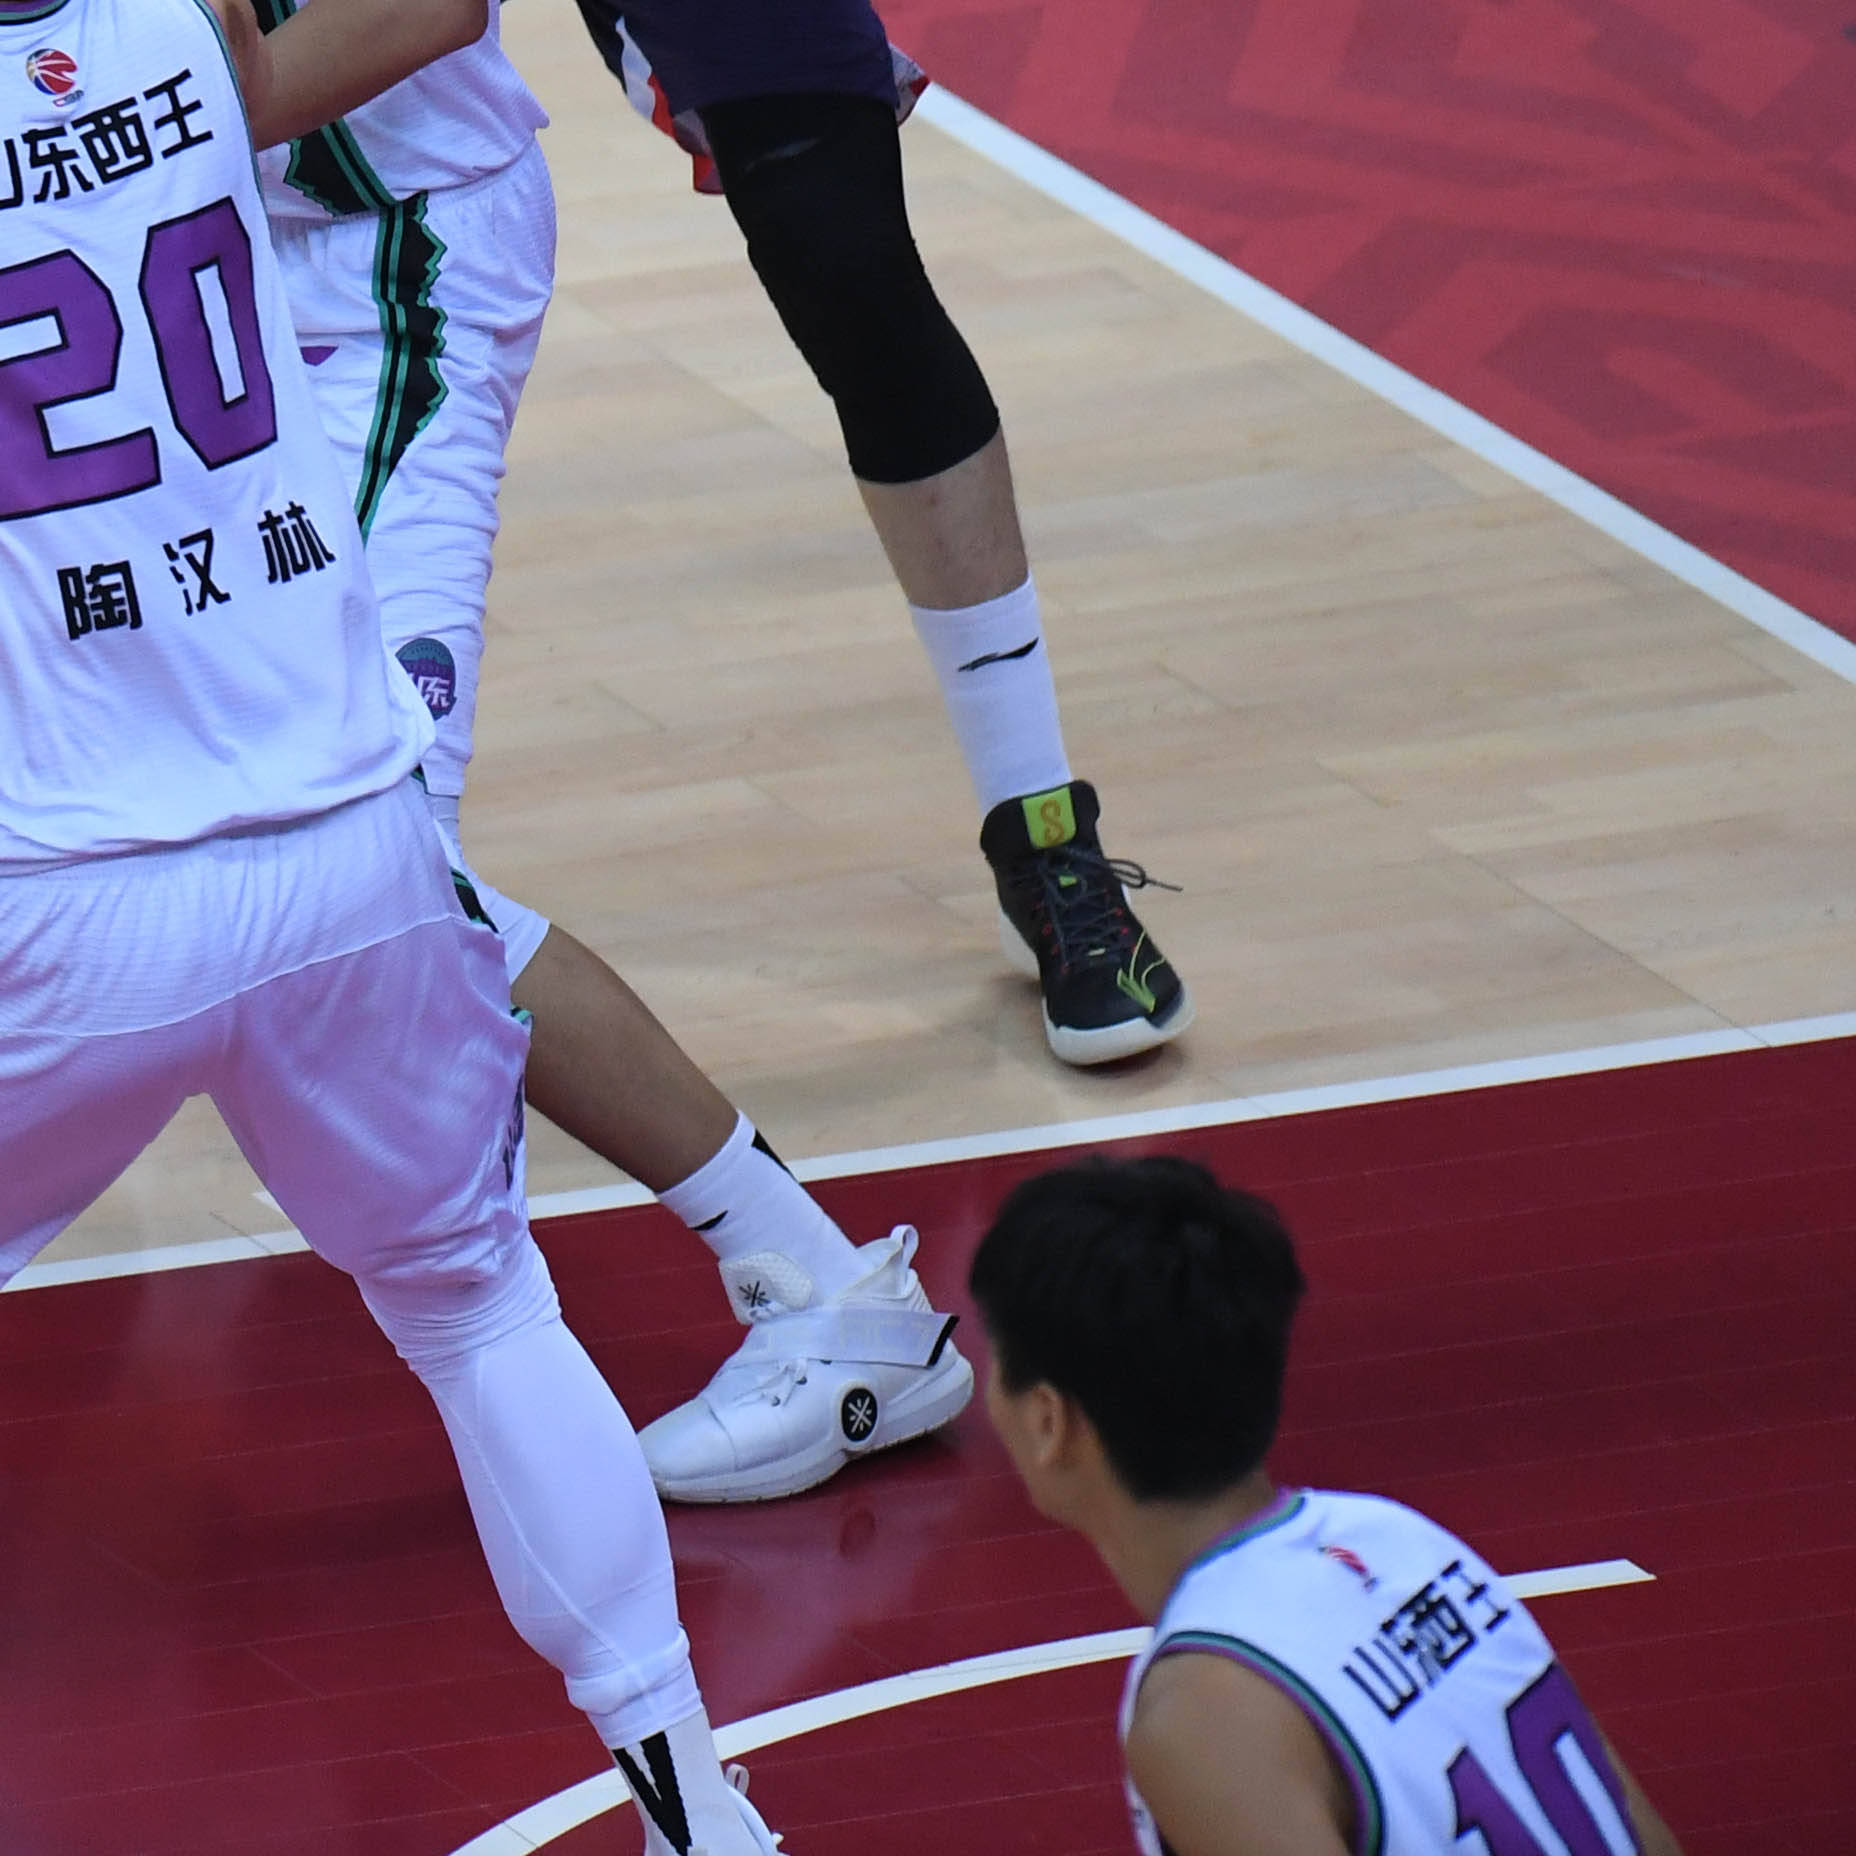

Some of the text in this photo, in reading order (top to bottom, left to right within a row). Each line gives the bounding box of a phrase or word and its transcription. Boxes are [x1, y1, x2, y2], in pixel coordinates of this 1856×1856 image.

[57, 501, 336, 640] 陶汉林
[1342, 1559, 1510, 1722] 山东西王
